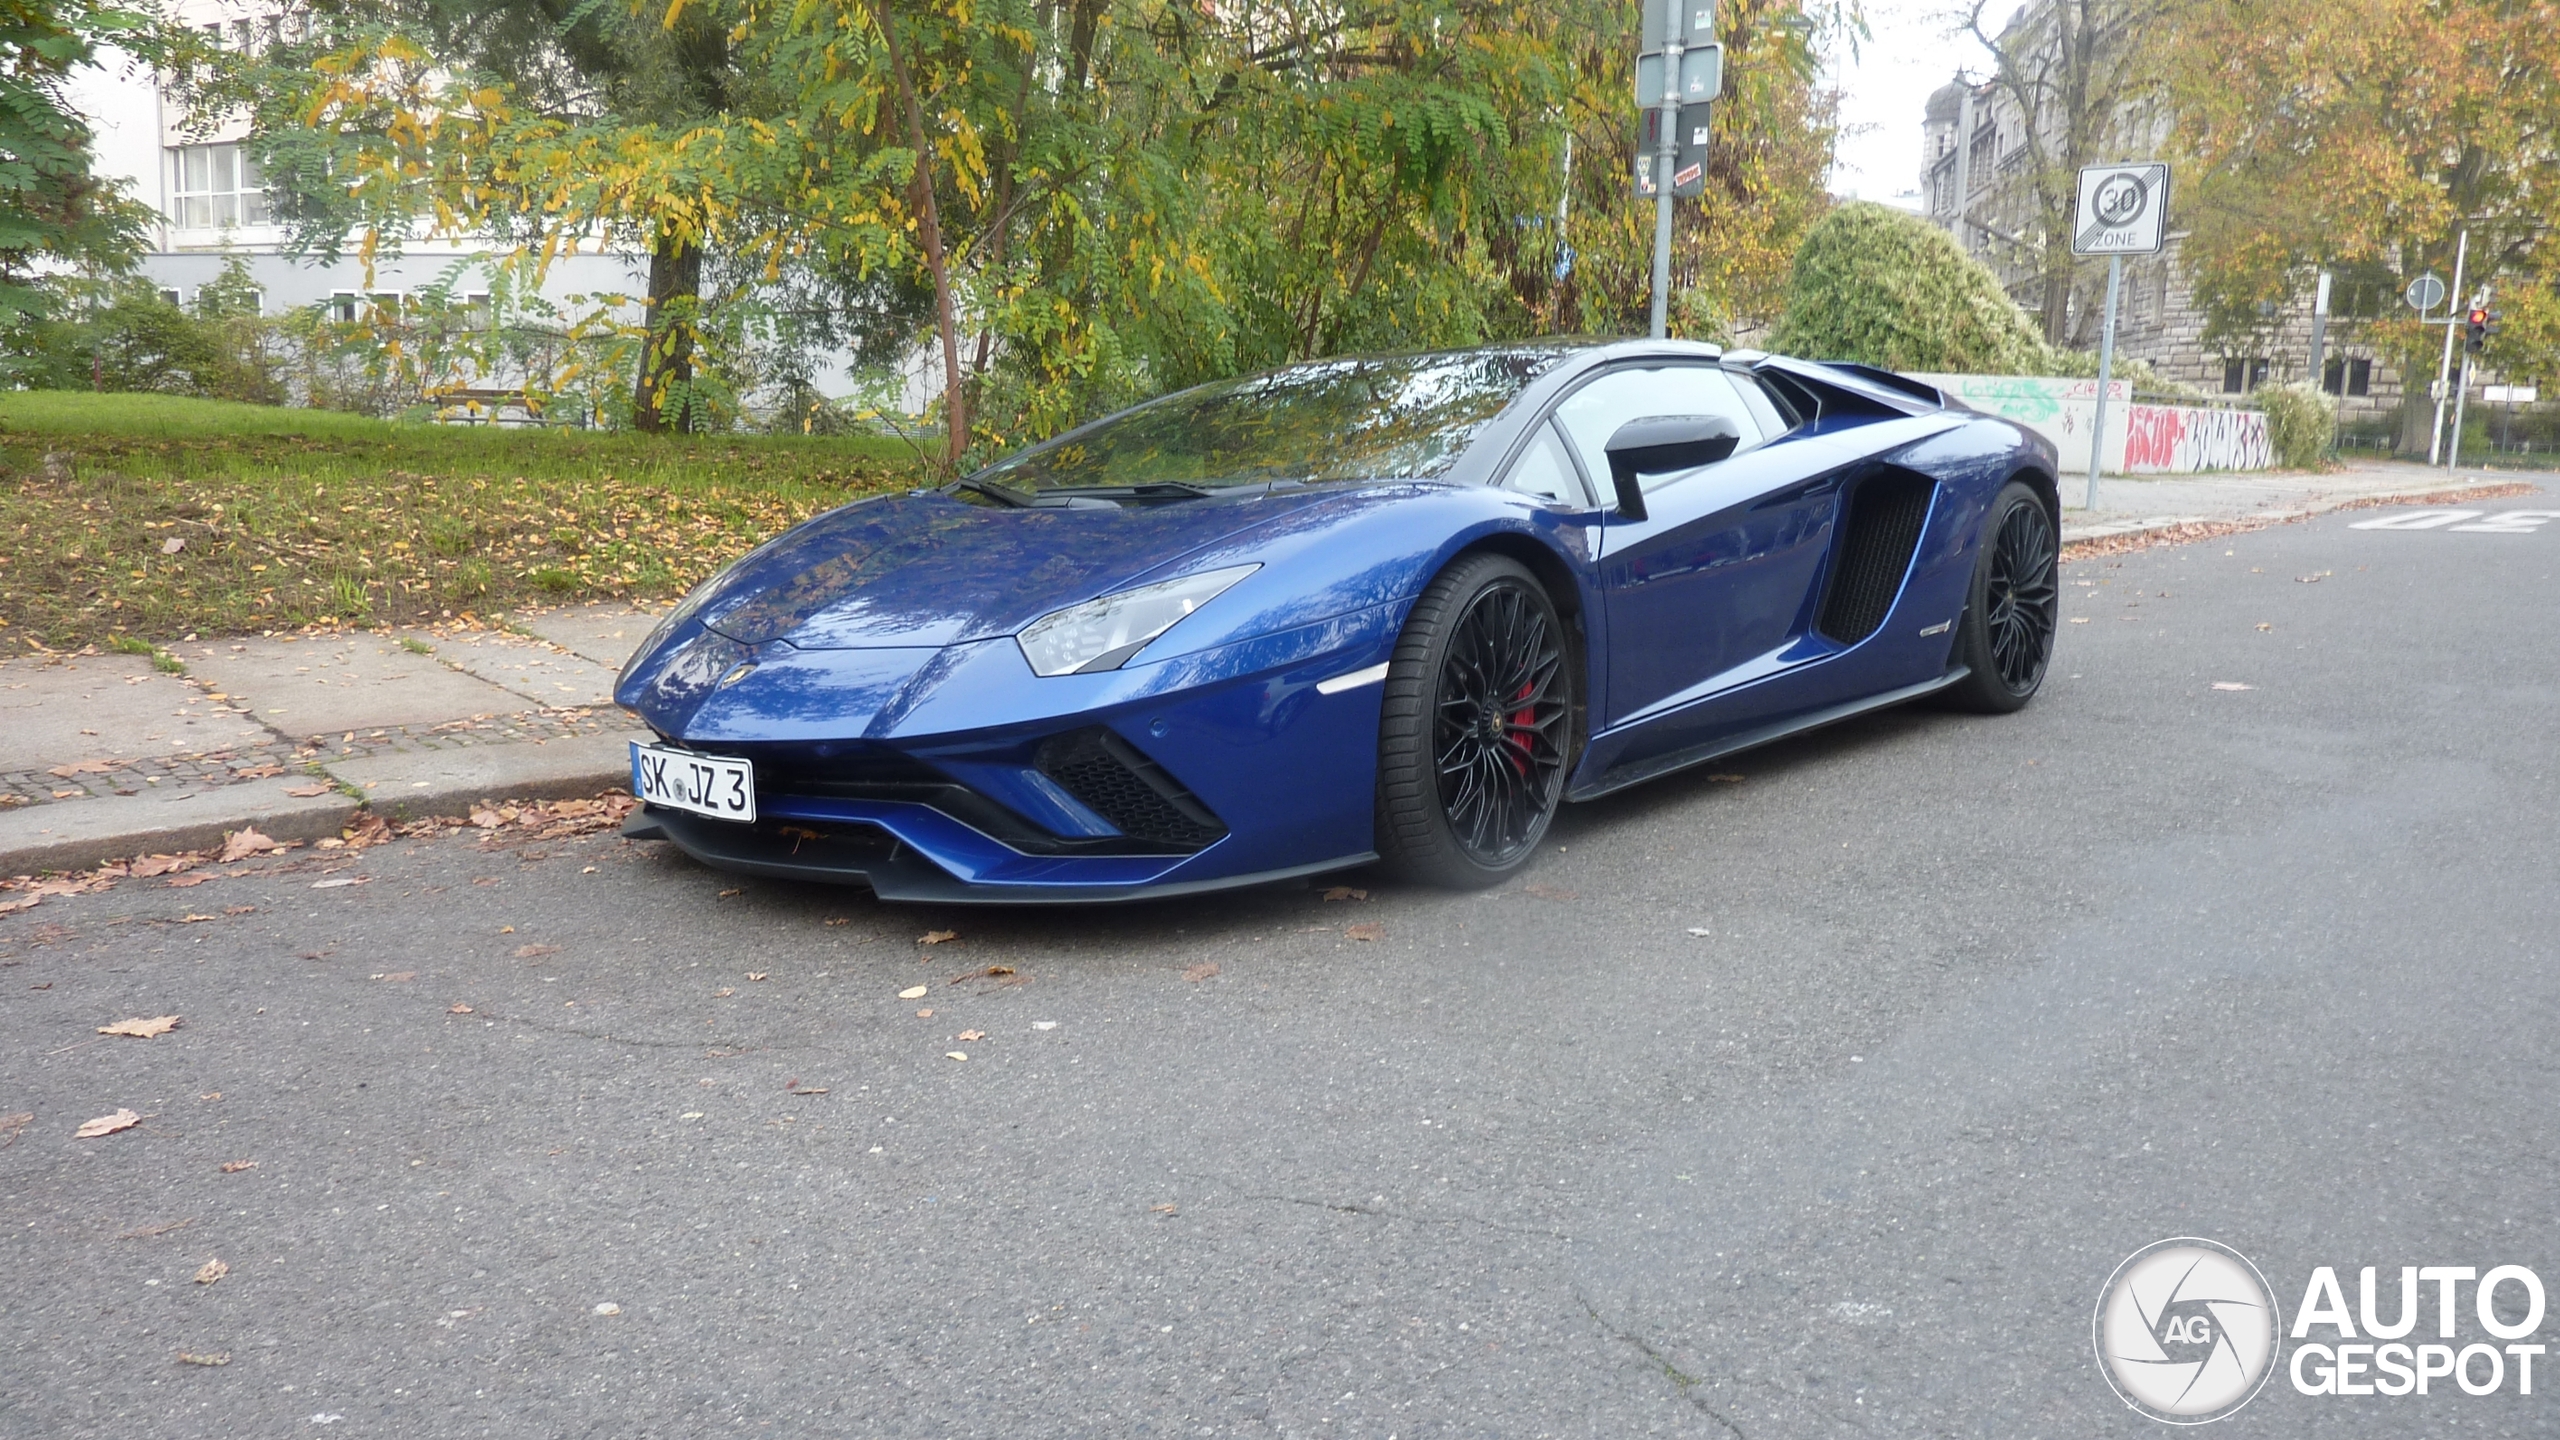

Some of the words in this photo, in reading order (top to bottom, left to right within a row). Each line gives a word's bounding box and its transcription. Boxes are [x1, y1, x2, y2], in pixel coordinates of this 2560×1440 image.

[2103, 187, 2137, 213] 30
[2094, 231, 2137, 247] ZONE
[641, 754, 671, 798] SK
[688, 763, 719, 809] JZ
[726, 769, 746, 811] 3
